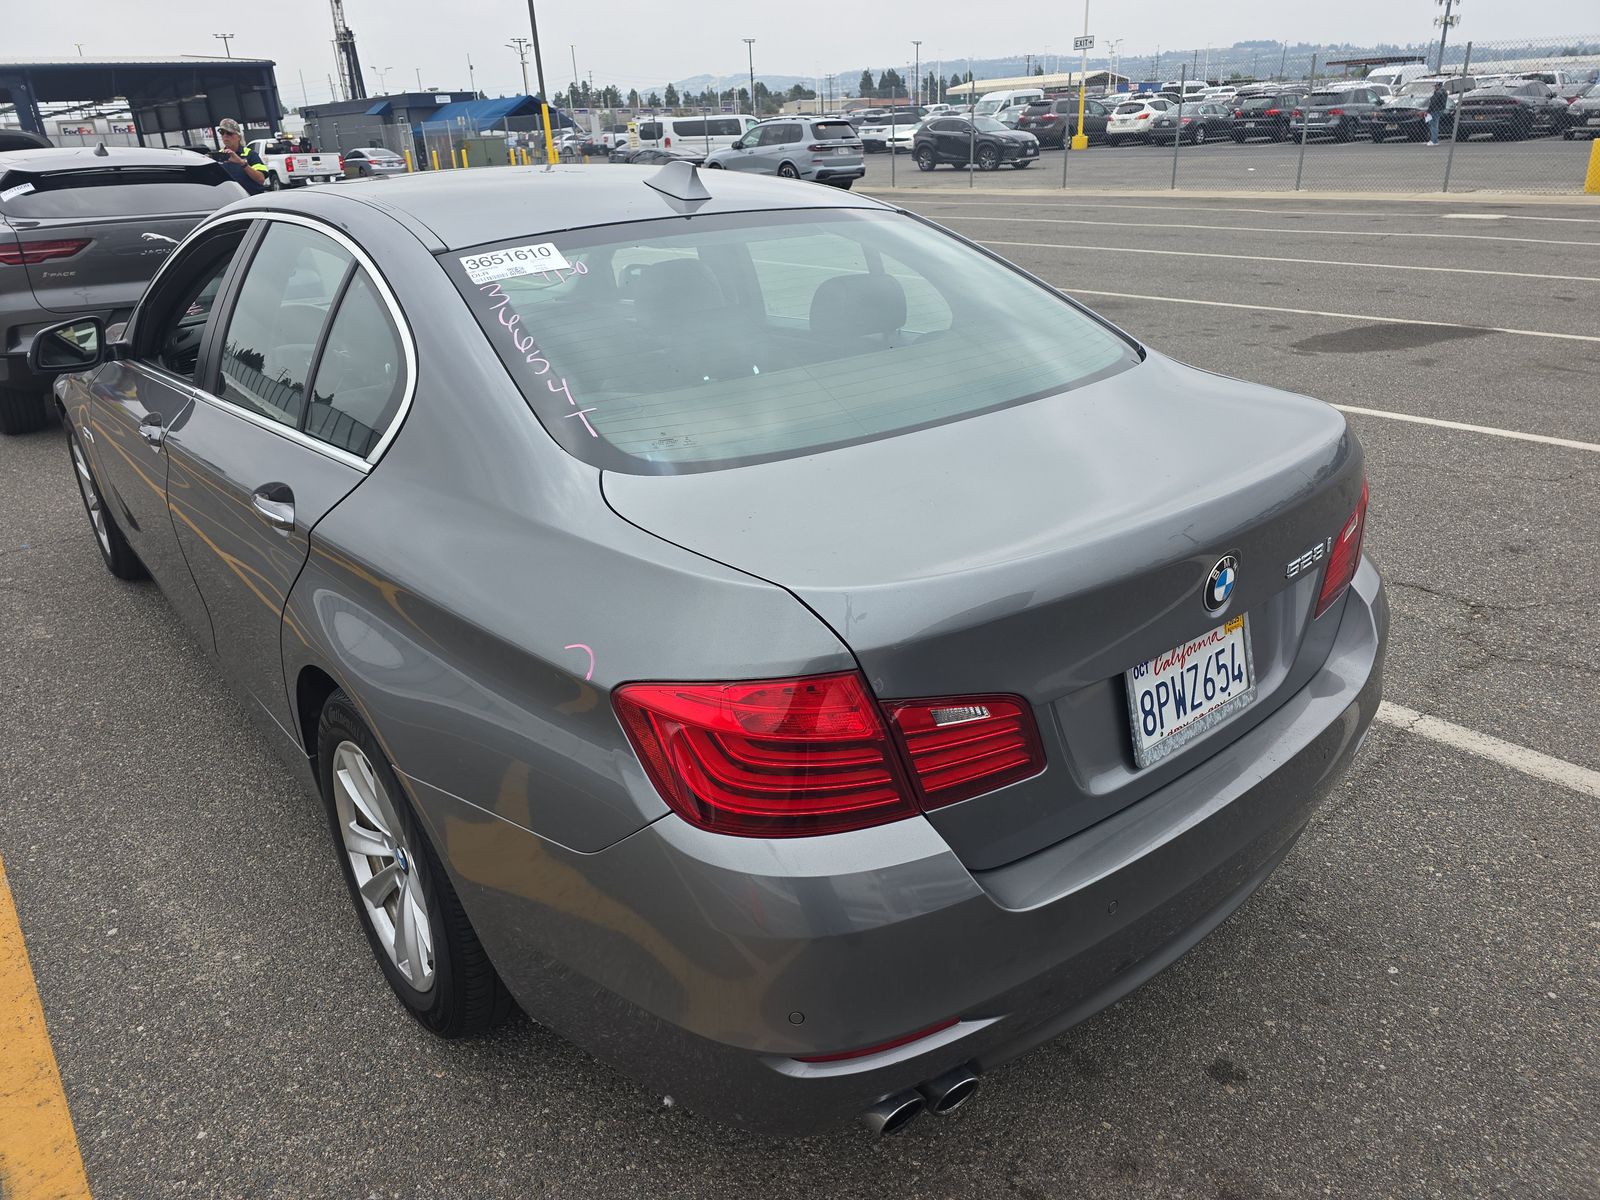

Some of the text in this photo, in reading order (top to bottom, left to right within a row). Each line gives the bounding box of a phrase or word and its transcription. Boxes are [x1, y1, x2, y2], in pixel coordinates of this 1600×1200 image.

[1075, 39, 1089, 48] EXIT
[62, 127, 93, 136] FedEx
[112, 123, 136, 134] FedE
[140, 247, 172, 256] JAGU
[465, 246, 552, 270] 3651610
[1286, 536, 1332, 578] 528i
[1211, 557, 1239, 581] BMW
[1153, 630, 1226, 676] California
[1133, 661, 1150, 680] OCT
[1140, 642, 1244, 737] 8PWZ654
